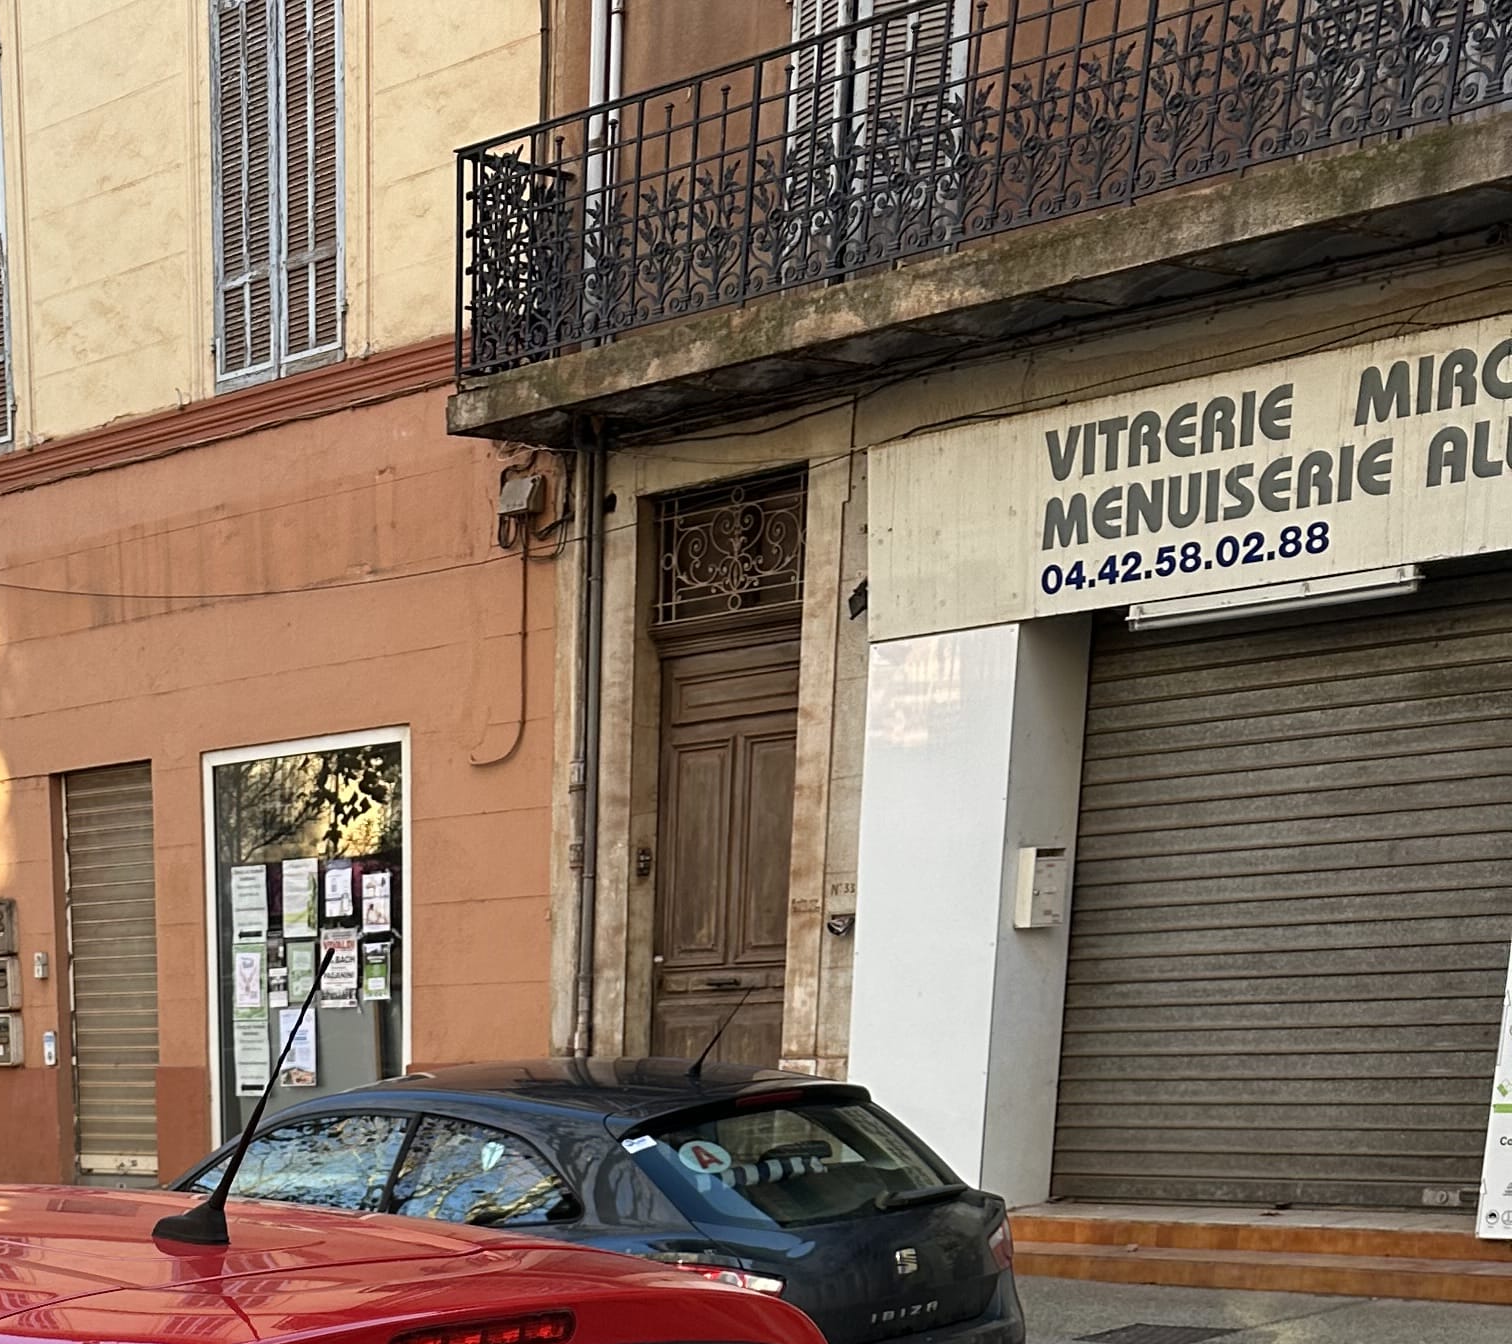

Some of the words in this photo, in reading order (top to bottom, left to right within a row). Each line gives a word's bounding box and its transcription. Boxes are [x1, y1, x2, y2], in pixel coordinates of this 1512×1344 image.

[1045, 383, 1294, 481] VITRERIE
[1042, 438, 1394, 550] MENUISERIE
[1426, 416, 1512, 488] AL
[1041, 521, 1330, 595] 04.42.58.02.88
[691, 1145, 723, 1169] A
[871, 1300, 938, 1323] IBIZA
